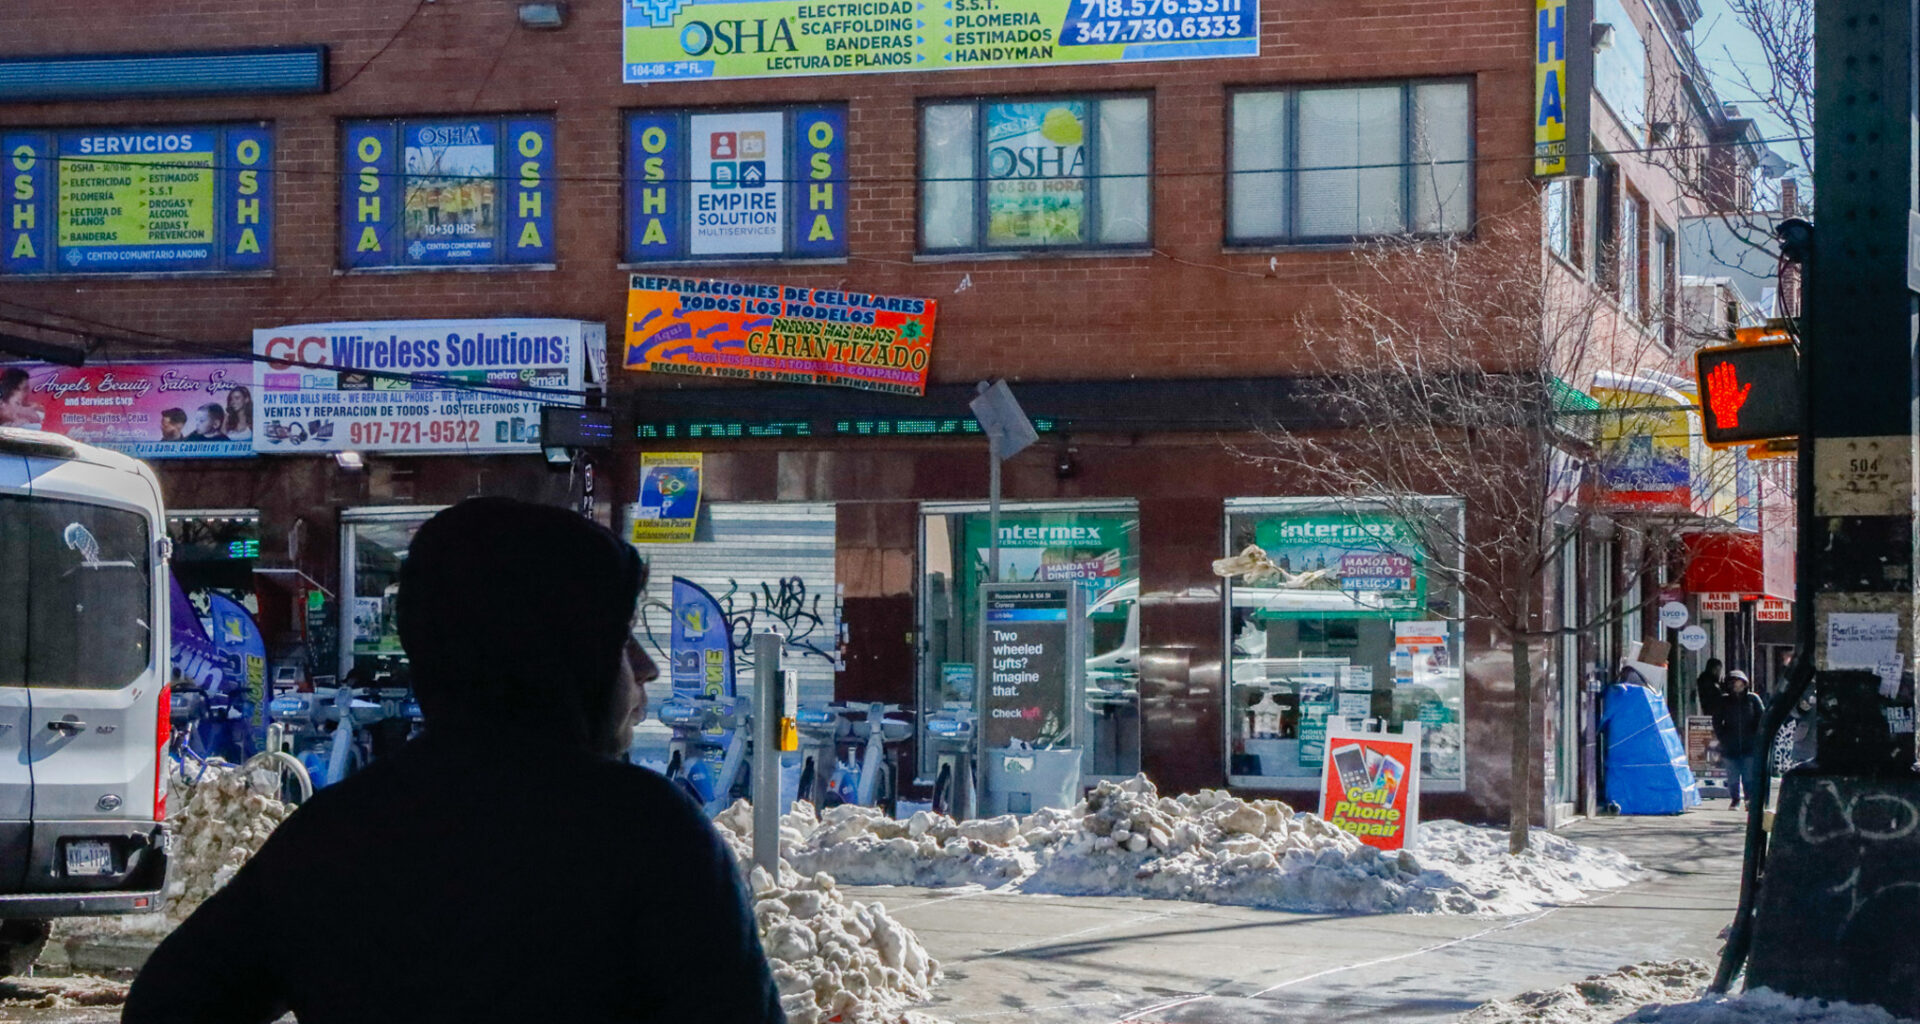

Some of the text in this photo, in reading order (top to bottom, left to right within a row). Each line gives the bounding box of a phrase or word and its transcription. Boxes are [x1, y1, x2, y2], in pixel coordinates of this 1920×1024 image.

[798, 1, 913, 18] ELECTRICIDAD
[956, 12, 1041, 28] PLOMERIA
[800, 20, 913, 35] SCAFFOLDING
[1076, 15, 1241, 43] 347.730.6333
[680, 17, 799, 57] OSHA
[956, 28, 1052, 45] ESTIMADOS
[826, 37, 913, 51] BANDERAS
[767, 52, 912, 70] LECTURA DE PLANOS
[956, 46, 1053, 62] HANDYMAN
[418, 126, 481, 145] OSHA
[80, 135, 192, 153] SERVICIOS
[70, 164, 95, 173] OSHA
[989, 145, 1085, 178] OSHA
[70, 177, 131, 186] ELECTRICIDAD
[149, 173, 199, 183] ESTIMADOS
[808, 121, 834, 242] OSHA
[518, 131, 543, 248] OSHA
[641, 126, 668, 245] OSHA
[12, 145, 36, 258] OSHA
[236, 139, 261, 254] OSHA
[357, 137, 382, 252] OSHA
[698, 192, 777, 211] EMPIRE
[149, 199, 194, 209] DROGAS Y
[70, 207, 123, 217] LECTURA DE
[149, 209, 189, 219] ALCOHOL
[698, 211, 777, 226] SOLUTION
[70, 216, 105, 226] PLANOS
[182, 221, 189, 230] Y
[149, 230, 205, 240] PREVENCION
[456, 224, 476, 235] HRS
[698, 226, 777, 237] MULTISERVICES
[70, 232, 118, 242] BANDERAS
[426, 242, 450, 250] CENTRO
[87, 249, 207, 261] CENTRO COMUNITARIO ANDINO
[631, 275, 925, 314] REPARACIONES DE CELULARES
[680, 295, 876, 325] TODOS LOS MODELOS
[772, 318, 896, 344] PRECIOS MAS BAJOS
[264, 336, 327, 371] GC
[331, 335, 440, 368] Wireless
[446, 332, 563, 367] Solutions
[747, 332, 927, 371] GARANTIZADO
[688, 352, 718, 363] PAGA
[720, 353, 741, 364] TUS
[825, 362, 846, 374] LAS
[487, 371, 518, 381] metro
[520, 369, 536, 381] Go
[529, 374, 566, 387] smart
[651, 362, 922, 395] RECARGA A TODOS LOS PAISES DE LATINOAMERICA
[97, 374, 152, 398] Beauty
[158, 369, 201, 393] Salon
[65, 397, 79, 406] and
[80, 397, 114, 406] Services
[264, 394, 279, 404] PAY
[280, 393, 299, 404] YOUR
[300, 393, 319, 404] BILLS
[321, 392, 341, 403] HERE
[349, 393, 363, 403] WE
[365, 392, 388, 403] REPAIR
[390, 392, 403, 403] ALL
[405, 392, 434, 402] PHONES
[442, 391, 452, 401] WE
[264, 407, 301, 418] VENTAS
[304, 407, 310, 417] Y
[313, 406, 377, 418] REPARACION
[380, 406, 393, 416] DE
[397, 405, 429, 416] TODOS
[440, 405, 459, 415] LOS
[463, 403, 519, 414] TELEFONOS
[523, 403, 529, 413] Y
[62, 413, 148, 424] Tintes Rayitos Cejas
[350, 420, 480, 444] 917-721-9522
[136, 443, 154, 453] Para
[180, 443, 220, 453] Caballeros
[1850, 459, 1878, 472] 504
[999, 524, 1101, 540] ntermex
[1280, 521, 1396, 538] intermex
[1047, 562, 1098, 572] MANDA TU
[1345, 557, 1408, 566] MANDA TU
[1047, 571, 1084, 580] DINERO
[1348, 566, 1392, 576] DINERO
[1702, 602, 1738, 611] INSIDE
[1763, 600, 1784, 609] ATM
[1758, 611, 1790, 620] INSIDE
[993, 630, 1018, 641] Two
[993, 644, 1043, 655] wheeled
[993, 658, 1028, 671] Lyfts?
[992, 671, 1040, 685] Imagine
[992, 686, 1020, 697] that.
[992, 708, 1022, 718] Check
[1347, 787, 1389, 804] Cell
[1335, 801, 1401, 821] Phone
[1332, 817, 1400, 837] Repair
